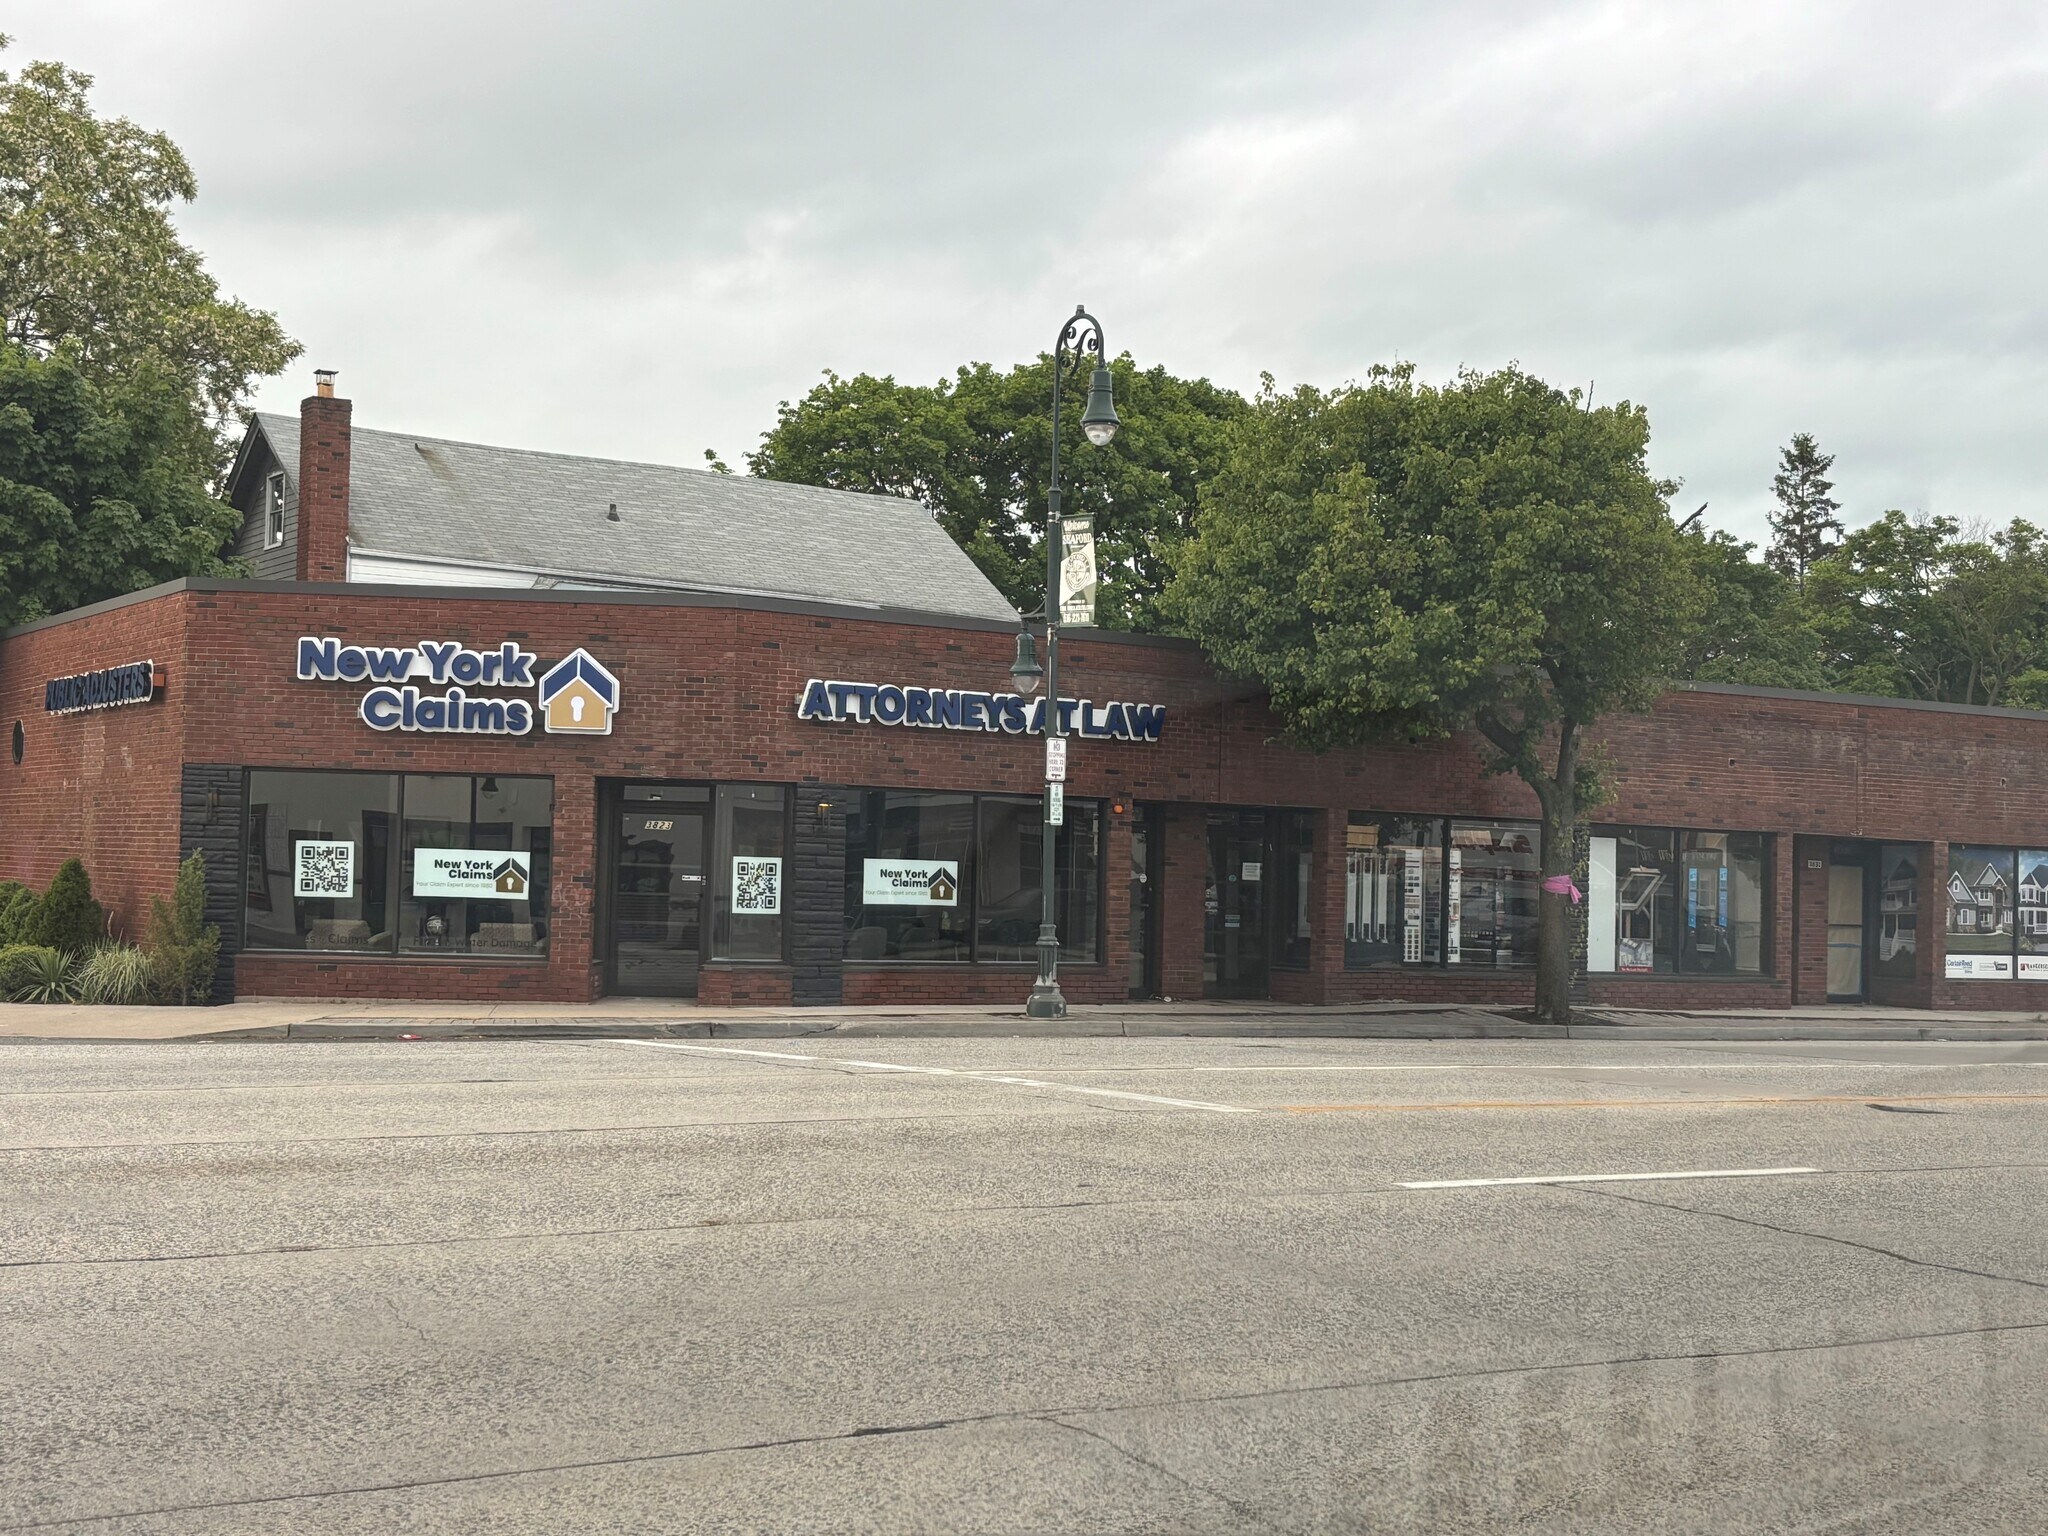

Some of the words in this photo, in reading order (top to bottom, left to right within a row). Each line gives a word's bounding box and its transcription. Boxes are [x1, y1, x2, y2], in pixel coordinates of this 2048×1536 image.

[1062, 533, 1092, 545] SEAFORD
[299, 639, 414, 679] New
[421, 642, 534, 683] York
[45, 674, 81, 712] PUBLIC
[82, 662, 148, 706] ADJUSTERS
[363, 689, 530, 732] Claims
[801, 681, 1026, 731] ATTORNEYS
[1081, 701, 1167, 739] LAW
[1053, 743, 1061, 751] NO
[646, 821, 672, 830] 3823
[434, 859, 462, 869] New
[464, 860, 494, 870] York
[448, 869, 495, 880] Claims
[880, 869, 903, 878] New
[904, 869, 928, 879] York
[891, 878, 928, 887] Claims
[328, 933, 369, 945] Claims
[454, 936, 488, 948] Wter
